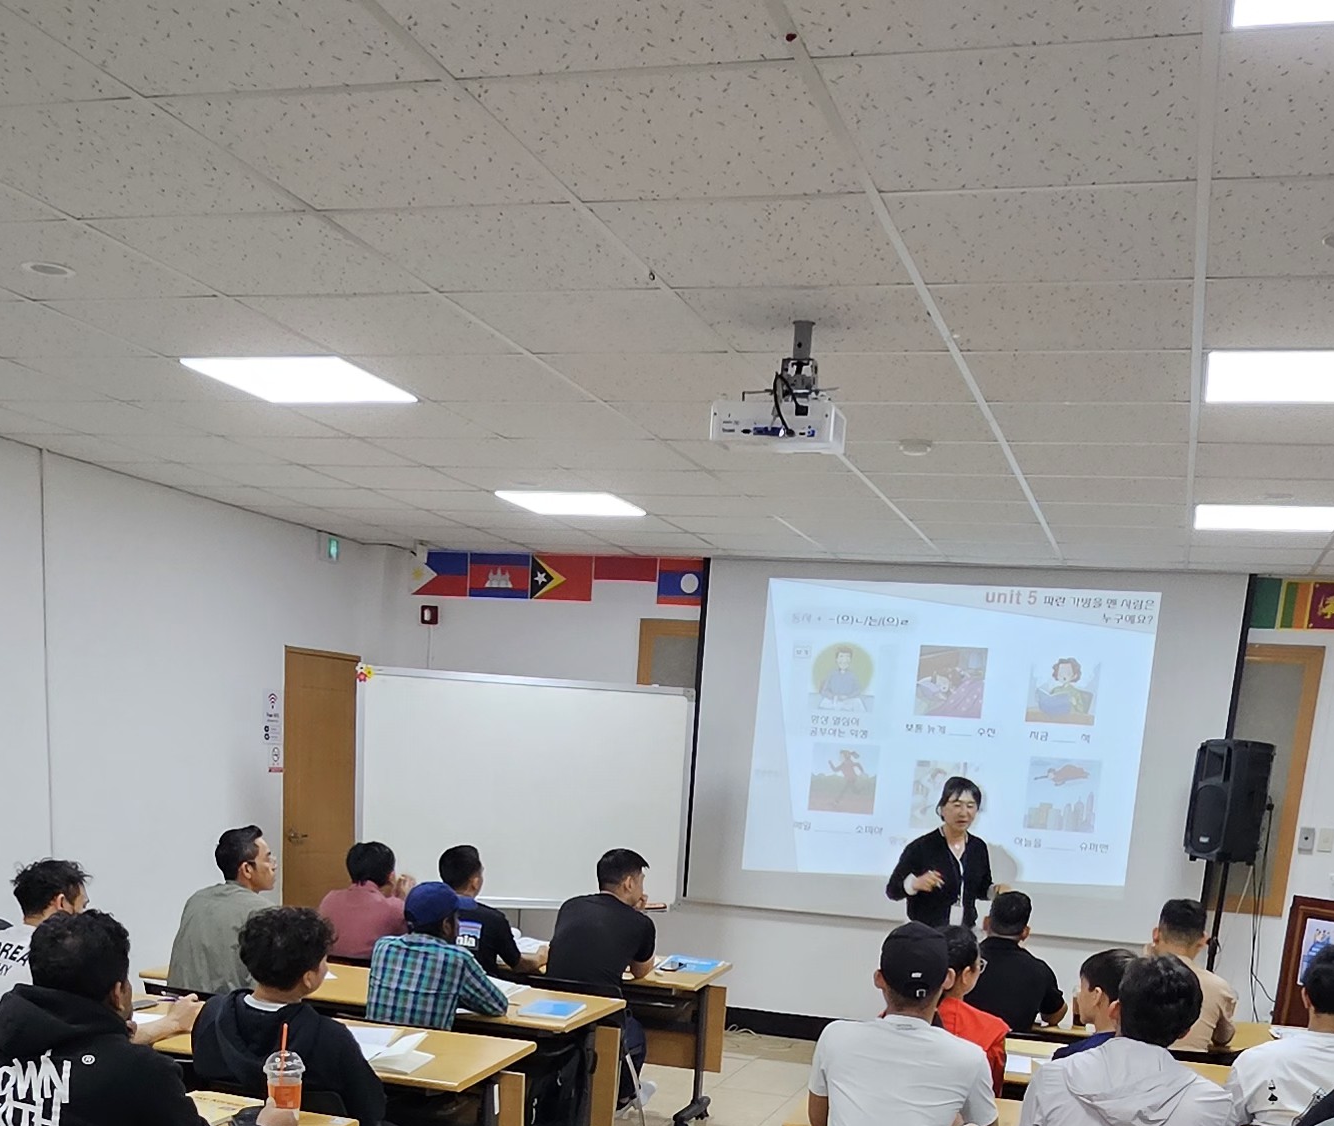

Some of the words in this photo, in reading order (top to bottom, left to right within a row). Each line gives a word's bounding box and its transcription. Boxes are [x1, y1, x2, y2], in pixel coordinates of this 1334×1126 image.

[985, 590, 1022, 605] unit
[1027, 590, 1038, 605] 5
[1120, 598, 1155, 610] 사람은
